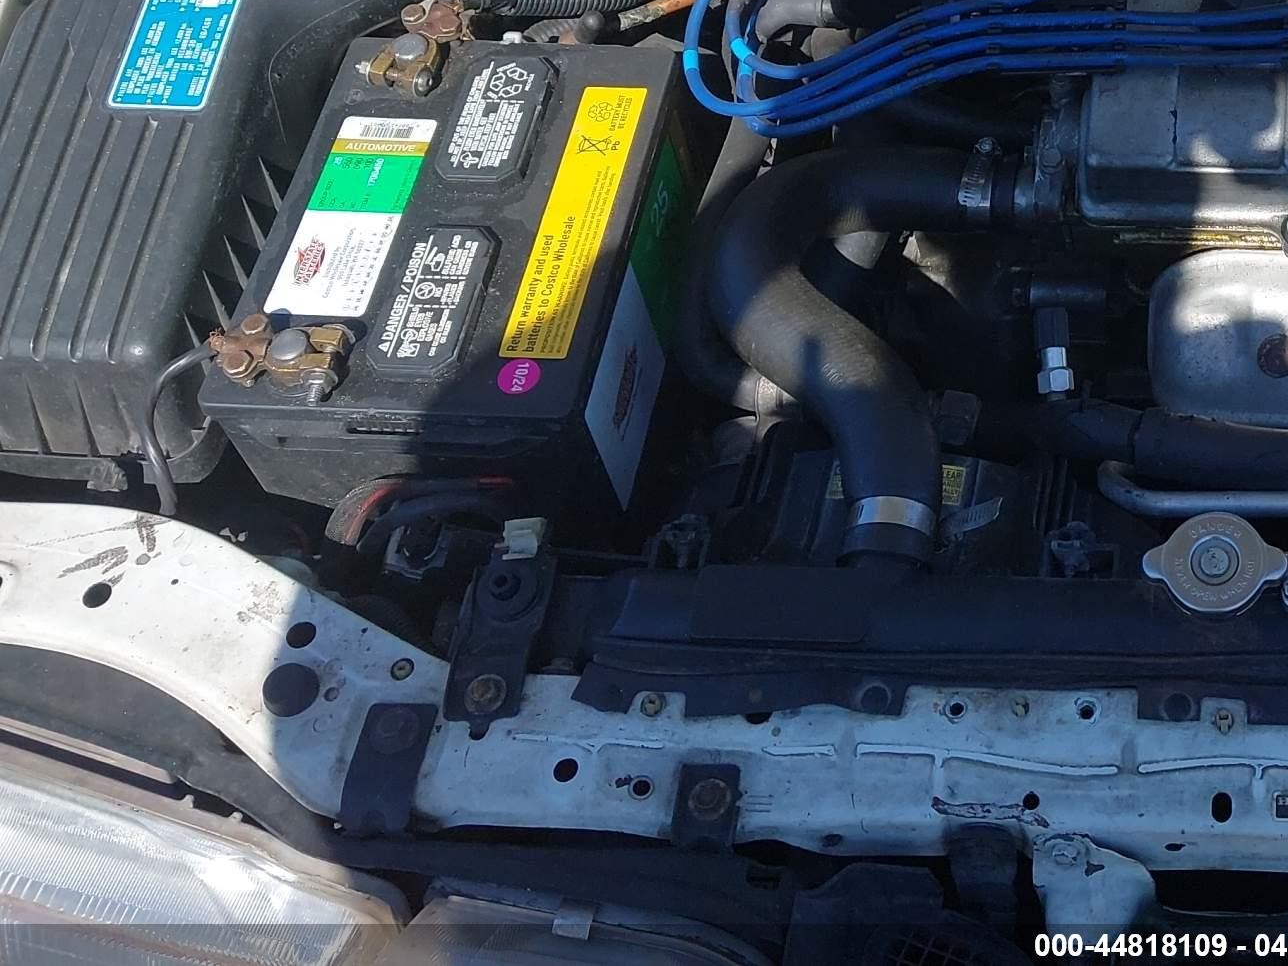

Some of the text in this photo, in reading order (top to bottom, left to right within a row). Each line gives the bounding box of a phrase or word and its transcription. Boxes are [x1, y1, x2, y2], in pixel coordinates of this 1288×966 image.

[345, 142, 417, 152] AUTOMOTIVE
[610, 139, 621, 151] Pb
[550, 215, 577, 262] Wholesale
[292, 238, 319, 285] INTERSTATE
[301, 240, 326, 284] BATTERIES
[539, 263, 562, 296] Costco
[381, 242, 427, 341] DANGER / POISON
[505, 234, 555, 352] Return warranty and used
[535, 297, 551, 308] to
[521, 309, 547, 353] batteries
[510, 362, 530, 392] 10/24
[1190, 522, 1243, 539] DANGER
